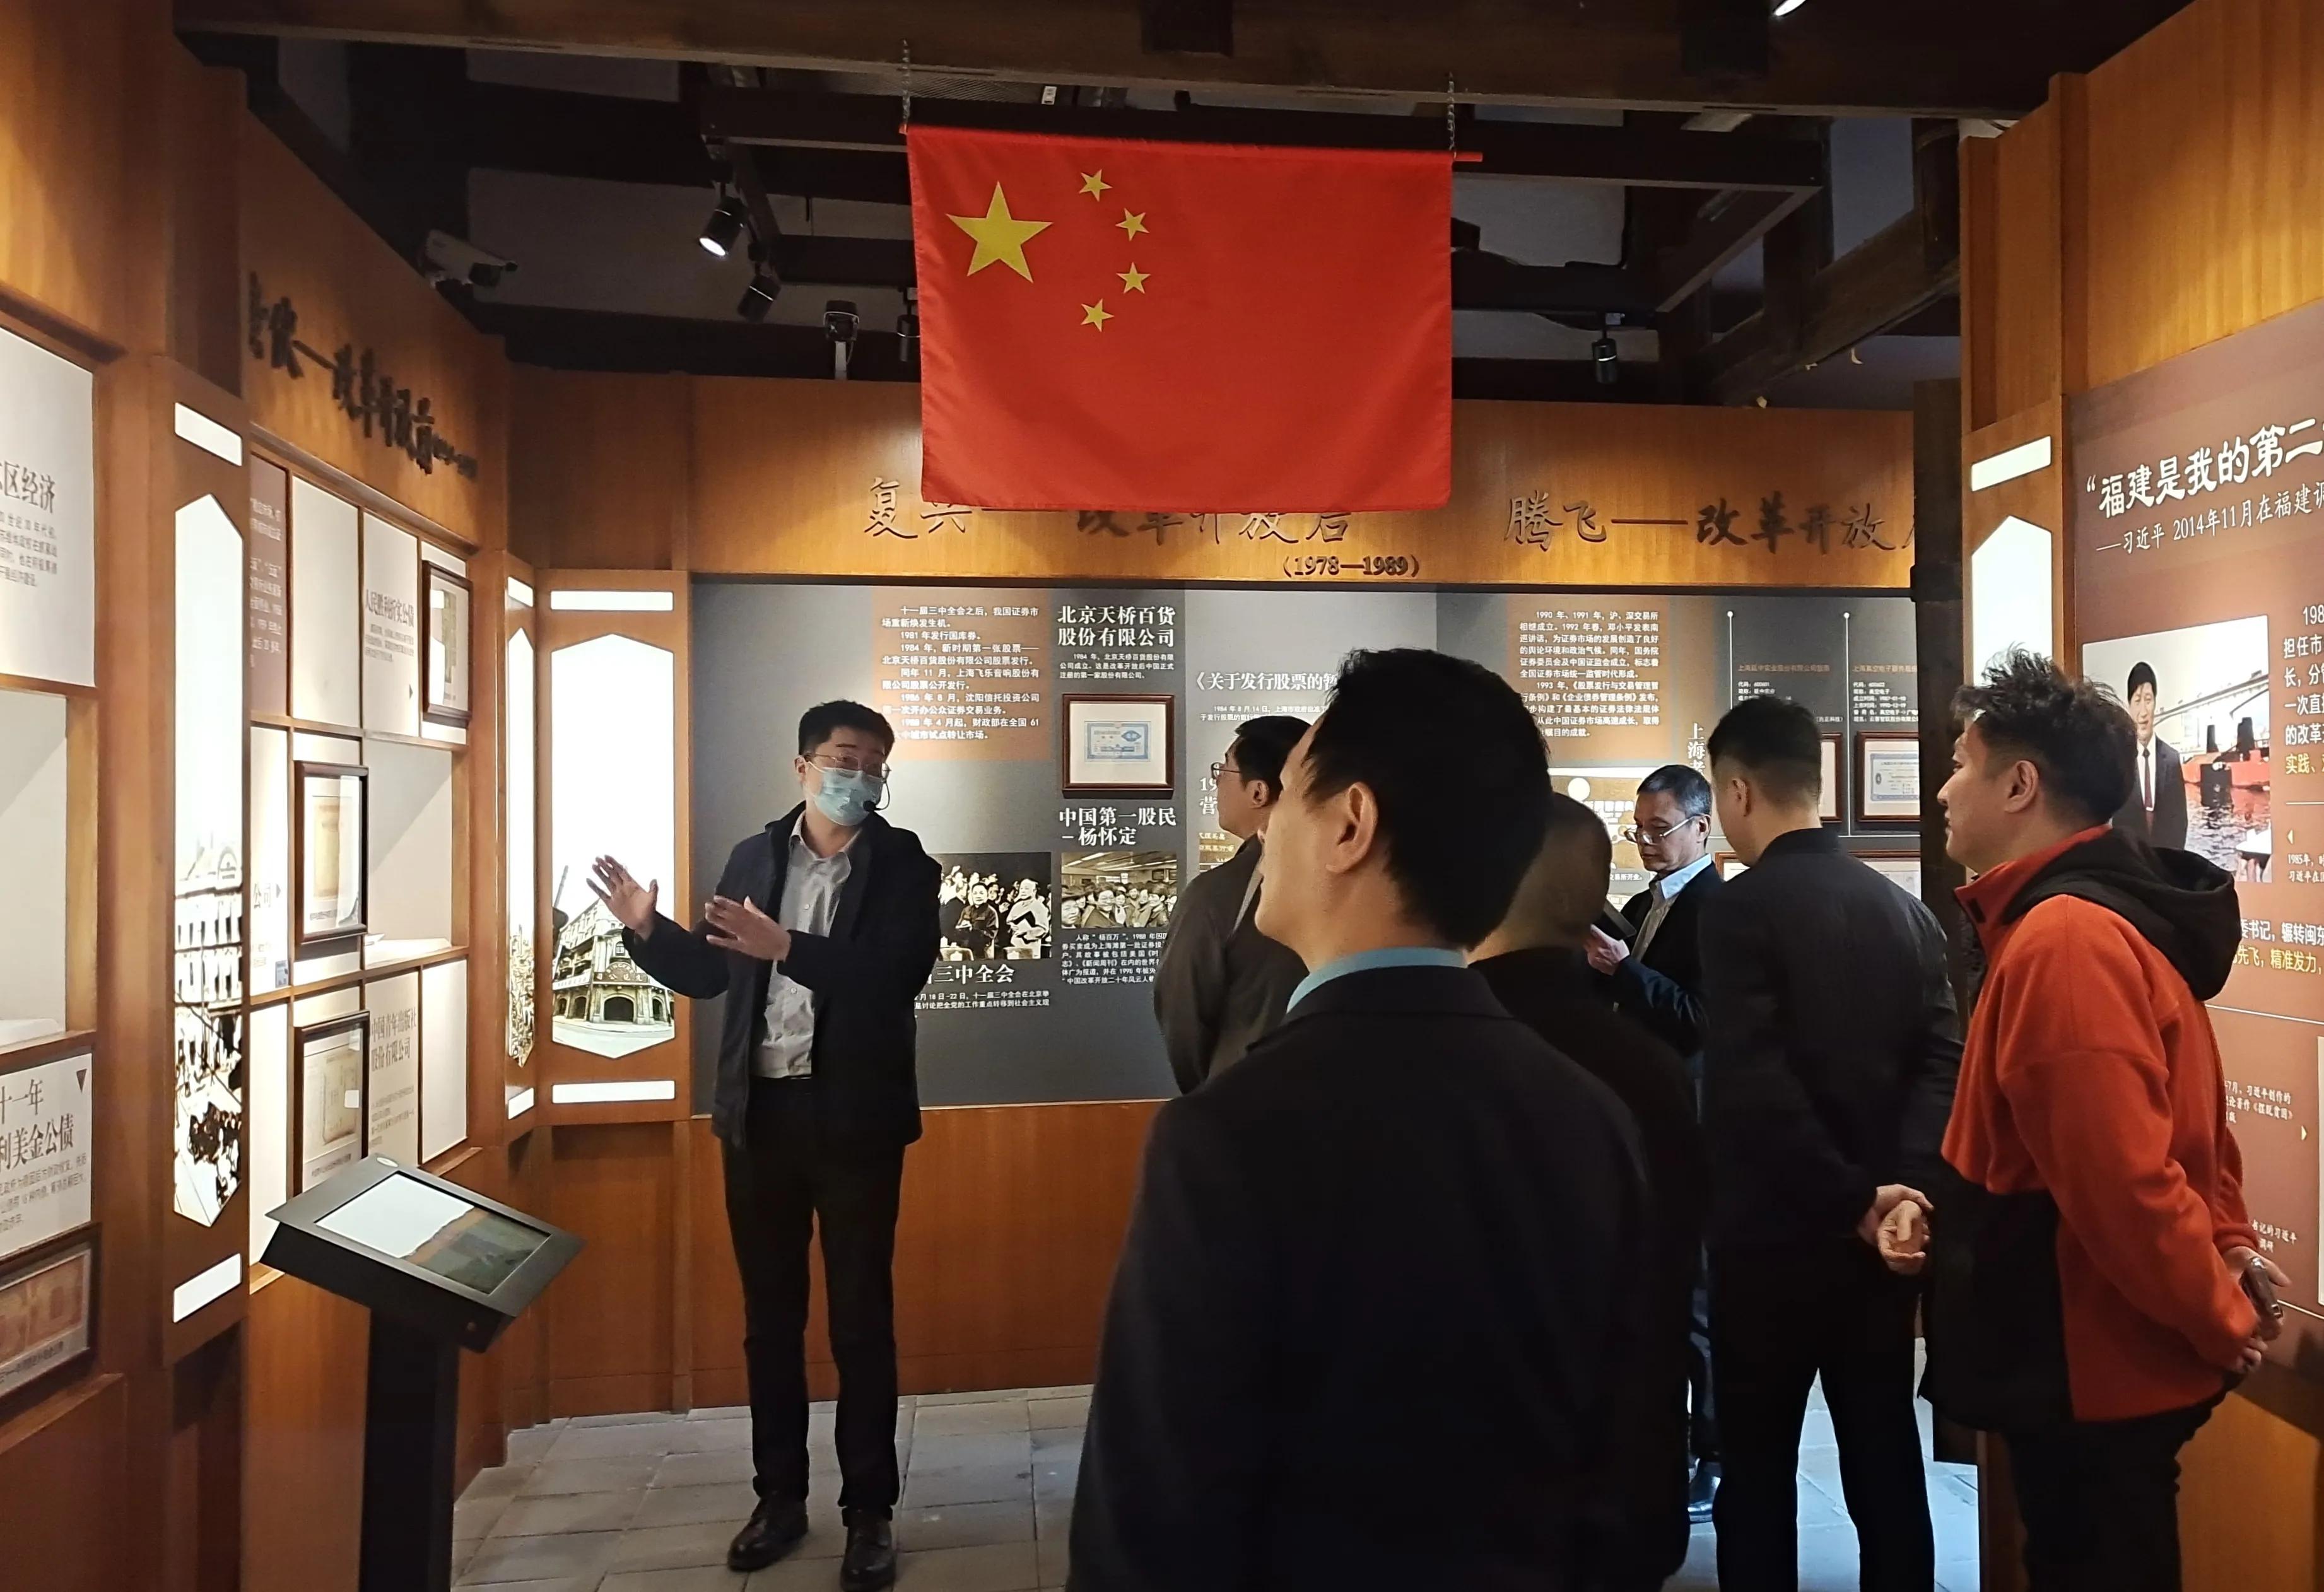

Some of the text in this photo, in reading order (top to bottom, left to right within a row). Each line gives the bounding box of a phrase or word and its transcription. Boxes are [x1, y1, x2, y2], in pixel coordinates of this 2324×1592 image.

[2087, 418, 2324, 518] “福建是我的第二
[0, 461, 56, 513] 区经济
[1504, 490, 1915, 554] 腾飞——改革开放
[901, 606, 1039, 616] 十一届三中全会之后，我国证券市
[1057, 605, 1176, 626] 北京天桥百货
[882, 618, 951, 628] 场重新焕发生机。
[1520, 623, 1658, 631] 相继成立。1992年春，邓小平发表南
[901, 631, 981, 640] 1981年发行国库券。
[1057, 627, 1175, 647] 股份有限公司
[1520, 635, 1659, 643] 巡讲话，为证券市场的发展创造了良好
[1520, 647, 1659, 655] 的舆论环境和政治气候。同年，国务院
[2284, 633, 2323, 659] 担任市
[882, 656, 1033, 665] 北京天桥百货股份有限公司股票发行。
[1520, 658, 1658, 667] 证券委员会及中国证监会成立，标志着
[901, 668, 1040, 678] 同年11月，上海飞乐音响股份有
[1520, 669, 1638, 678] 全国证券市场统一监管时代形成。
[2284, 662, 2324, 688] 长，分
[882, 681, 970, 690] 限公司股票公开发行。
[2284, 693, 2324, 715] 一次直
[2285, 722, 2324, 746] 的改革
[2285, 752, 2324, 775] 实践、
[1199, 797, 1218, 815] 营
[1059, 807, 1177, 826] 中国第一股民
[1062, 942, 1164, 950] 券买卖成为上海滩第一批证券投
[928, 963, 1015, 985] 三中全会
